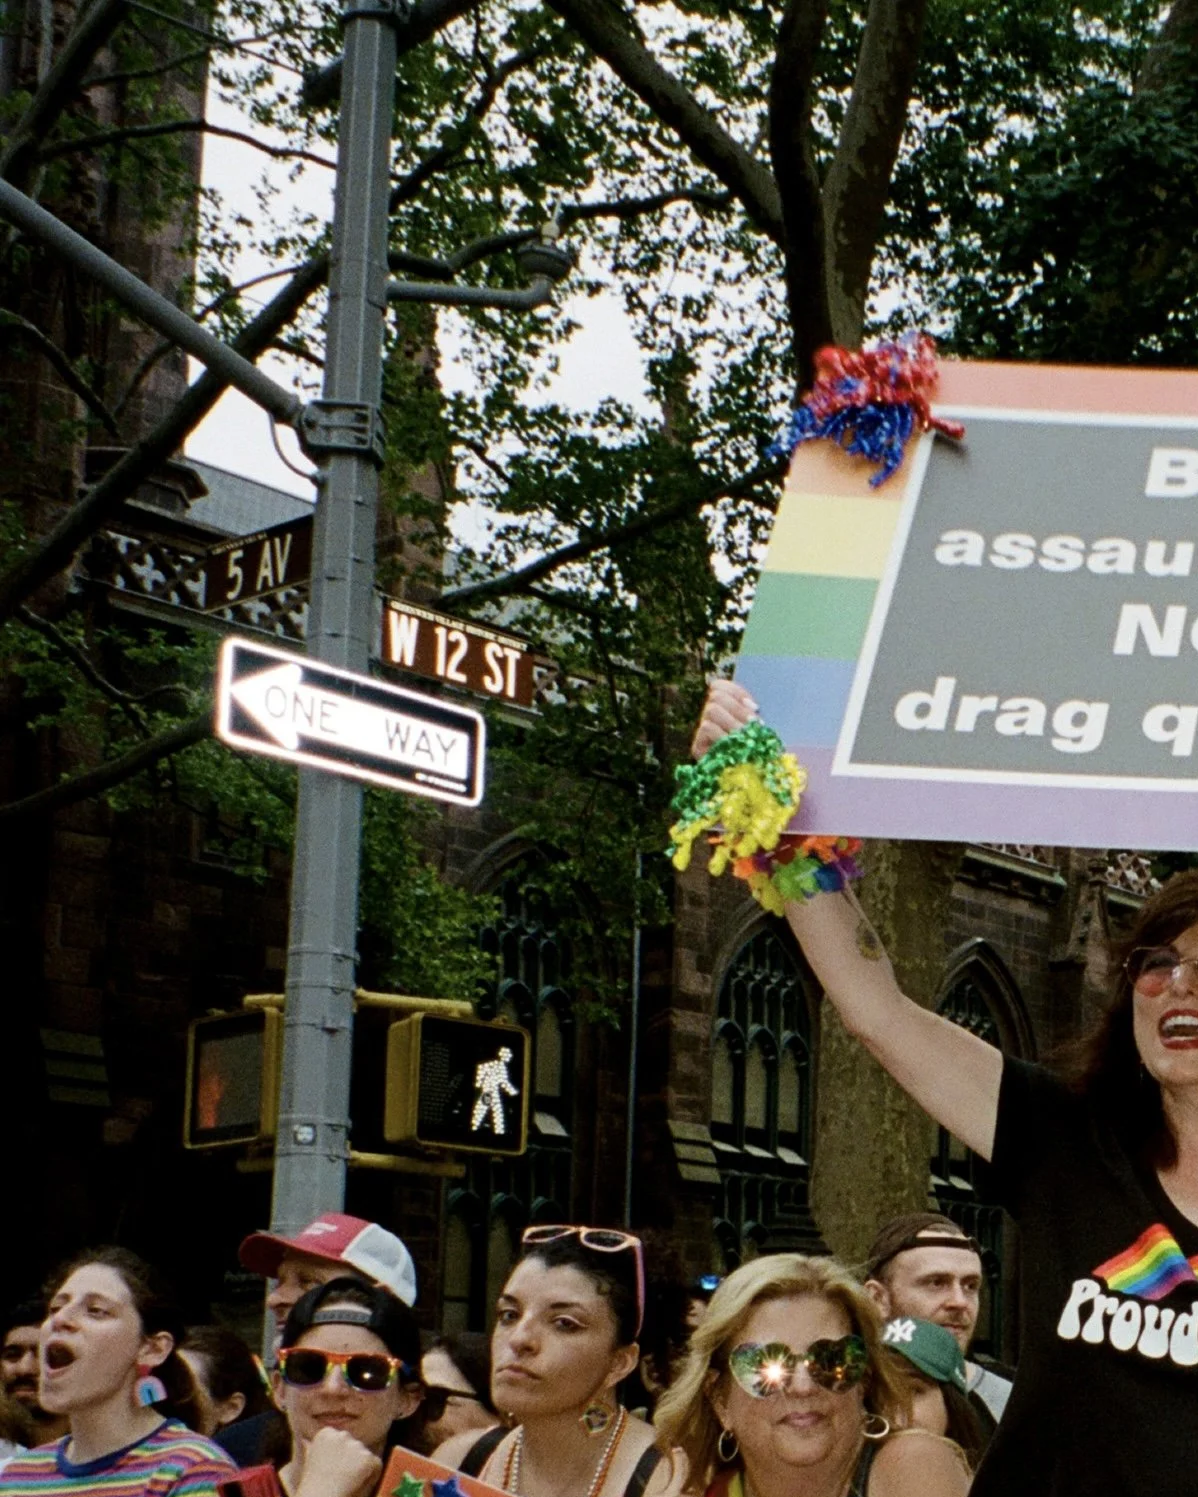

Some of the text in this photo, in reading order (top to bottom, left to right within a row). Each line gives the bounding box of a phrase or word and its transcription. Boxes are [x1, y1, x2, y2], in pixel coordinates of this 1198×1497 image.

[226, 549, 244, 600] 5
[256, 533, 293, 591] AV
[388, 610, 420, 667] W
[434, 626, 469, 684] 12
[483, 642, 522, 698] ST
[264, 685, 458, 768] ONE WAY
[894, 676, 1110, 754] drag
[883, 1318, 917, 1343] NY
